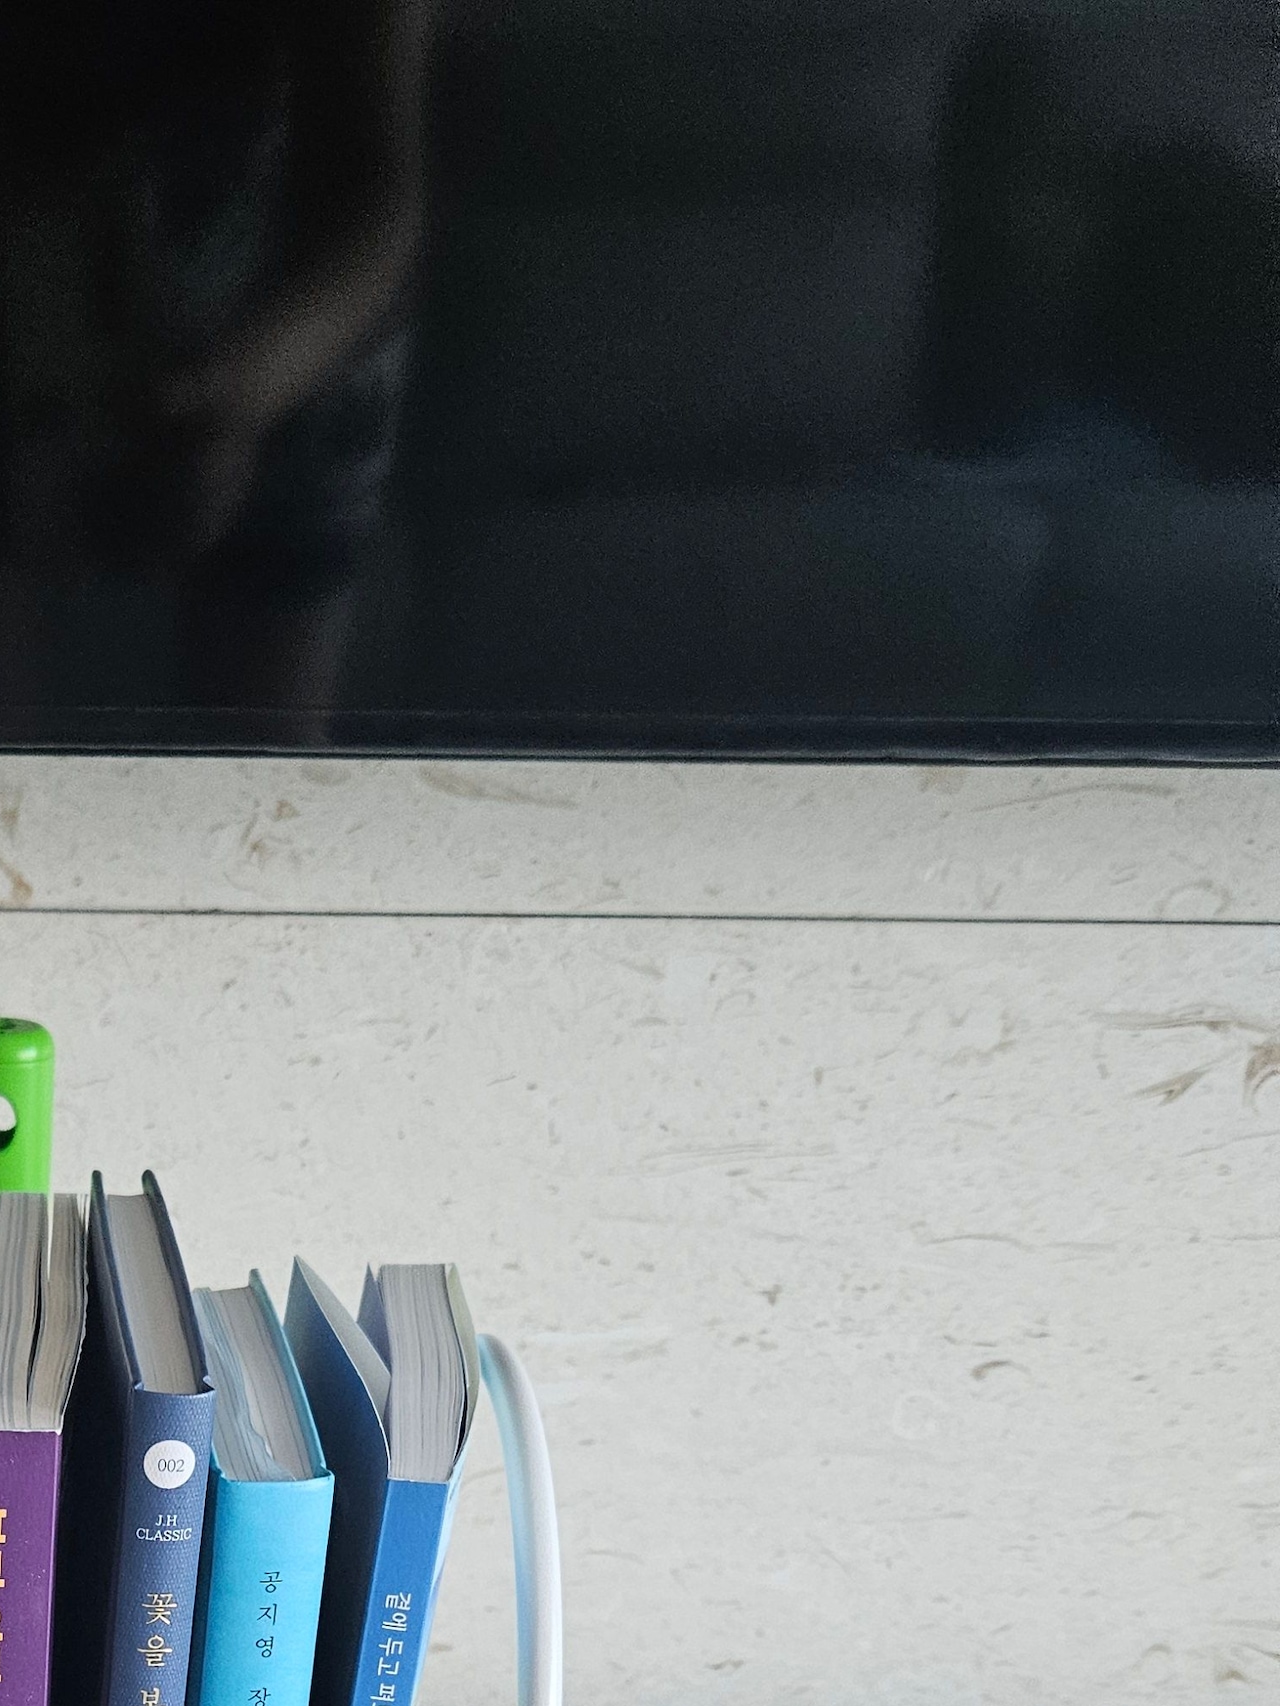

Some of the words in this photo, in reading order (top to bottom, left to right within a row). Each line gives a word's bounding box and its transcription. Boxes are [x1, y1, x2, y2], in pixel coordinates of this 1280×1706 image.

[157, 1458, 185, 1473] 002
[135, 1527, 193, 1542] CLASSIC
[155, 1514, 178, 1527] J.H
[137, 1593, 178, 1667] 꽃을
[255, 1571, 283, 1658] 공지영
[381, 1592, 412, 1632] 곁에
[377, 1637, 405, 1677] 두고
